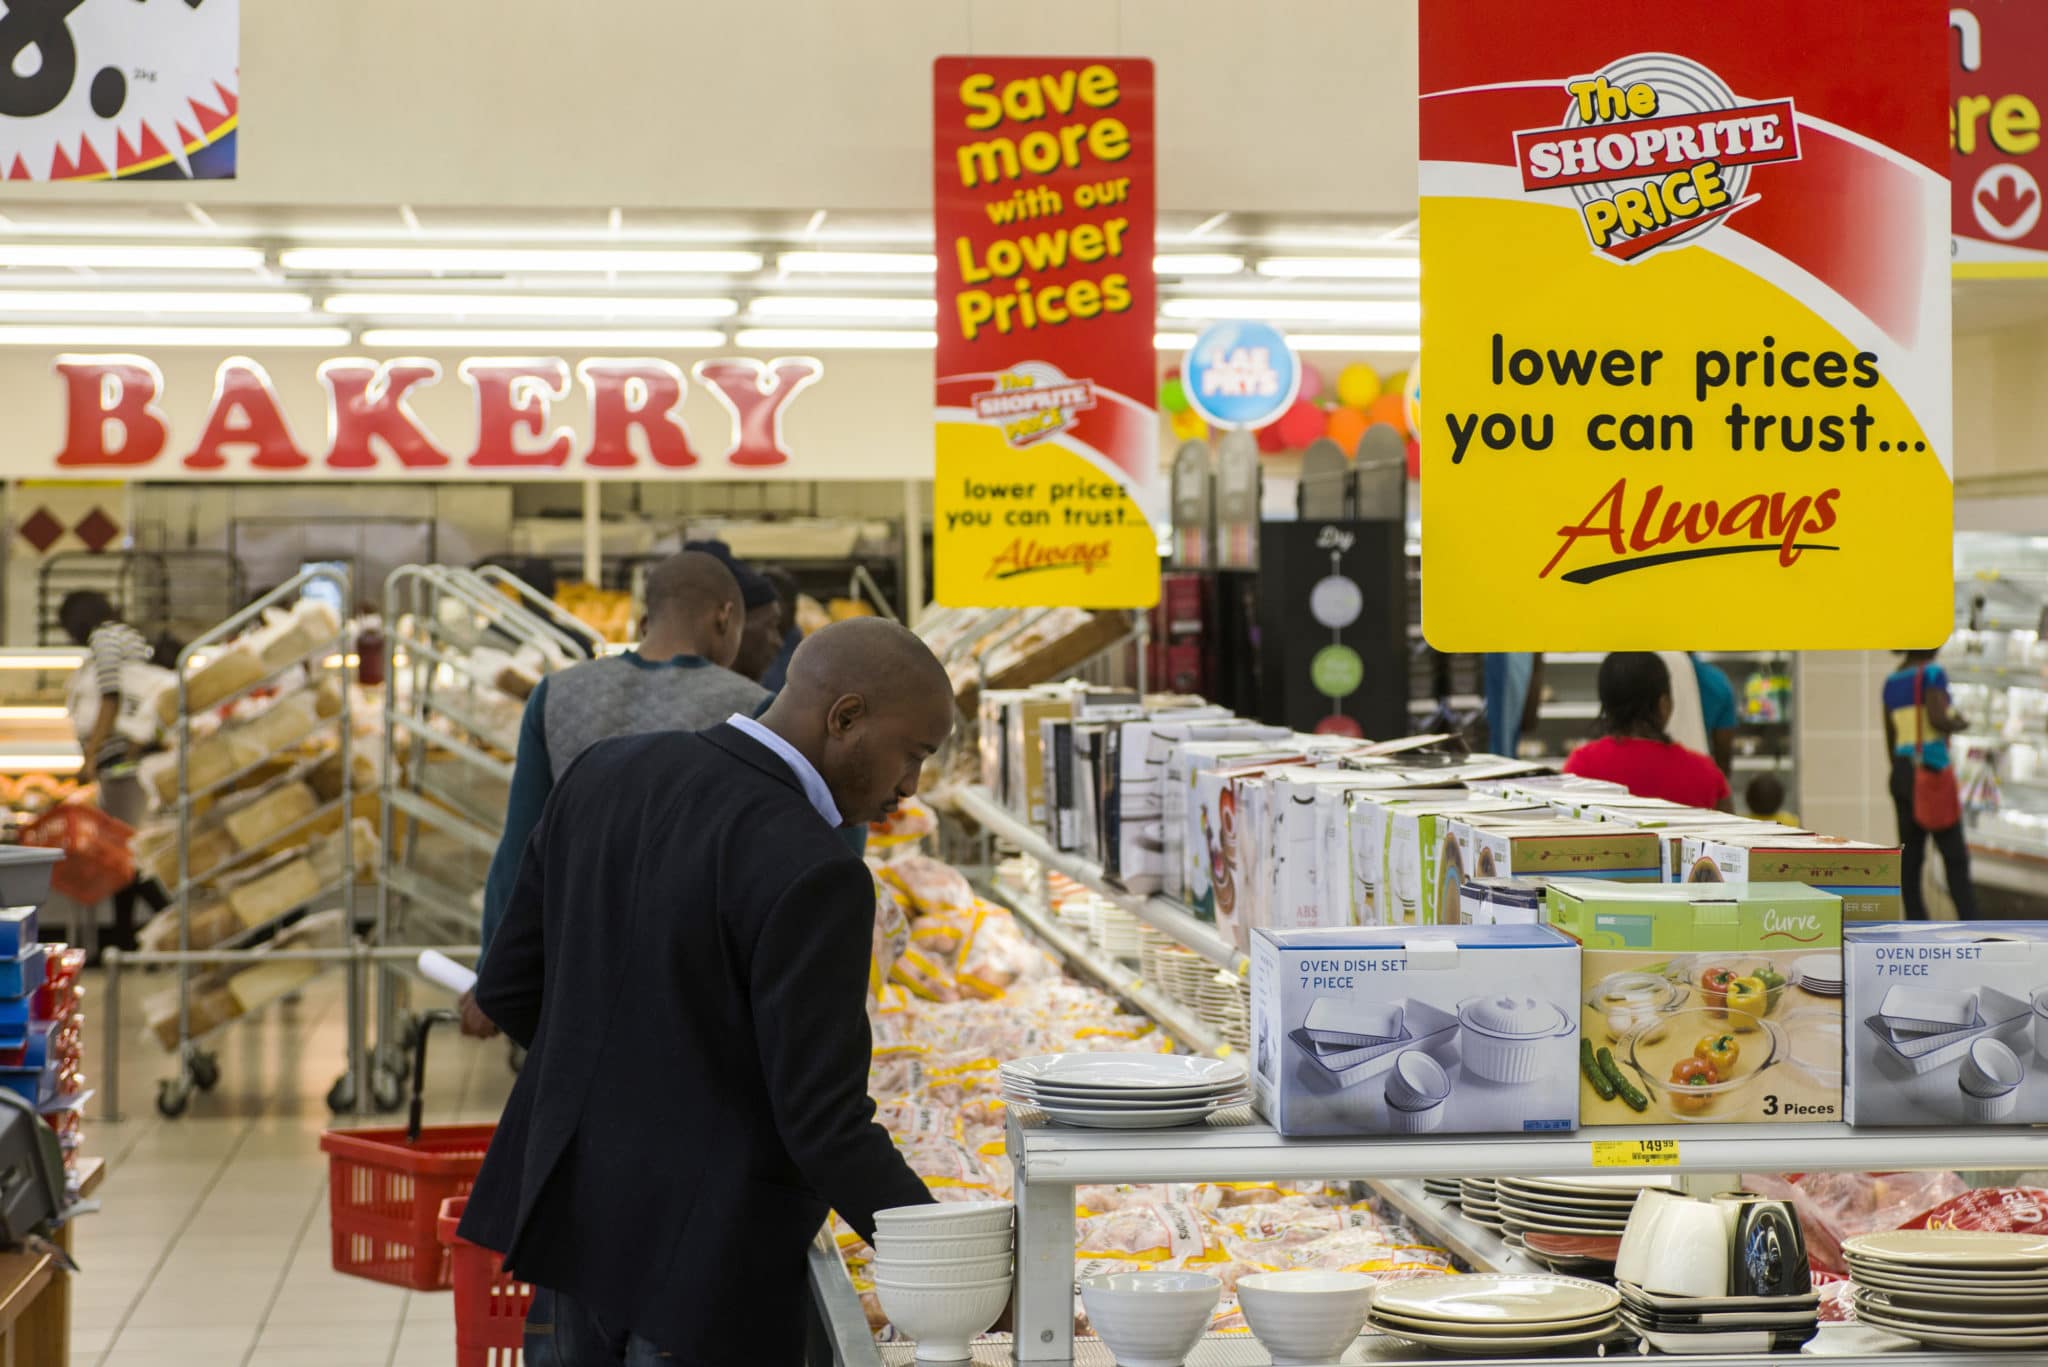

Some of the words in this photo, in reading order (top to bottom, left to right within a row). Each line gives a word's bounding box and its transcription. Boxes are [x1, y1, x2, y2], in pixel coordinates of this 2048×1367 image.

[133, 69, 157, 82] 2kg
[959, 64, 1119, 130] Save
[1570, 77, 1656, 123] The
[1528, 115, 1783, 178] SHOPRITE
[1949, 94, 2041, 155] re
[956, 117, 1131, 187] more
[986, 184, 1063, 225] with
[1074, 177, 1130, 209] our
[1584, 163, 1730, 248] PRICE
[955, 215, 1129, 284] Lower
[956, 272, 1132, 340] Prices
[1492, 333, 1662, 386] lower
[1696, 336, 1879, 402] prices
[50, 354, 824, 470] BAKERY
[979, 385, 1087, 414] SHOPRITE
[1445, 413, 1554, 465] you
[1587, 412, 1693, 452] can
[1726, 403, 1926, 453] trust...
[964, 478, 1037, 498] lower
[1050, 480, 1128, 505] prices
[946, 509, 991, 530] you
[1005, 509, 1050, 526] can
[1538, 477, 1840, 579] Always
[984, 538, 1111, 580] Always
[1763, 909, 1821, 931] Curve
[1861, 903, 1881, 912] SET
[1300, 960, 1339, 972] OVEN
[1344, 960, 1376, 972] DISH
[1381, 959, 1408, 972] SET
[1876, 948, 1914, 960] OVEN
[1919, 948, 1951, 960] DISH
[1956, 947, 1982, 960] SET
[1876, 965, 1884, 976] 7
[1889, 965, 1929, 976] PIECE
[1300, 977, 1308, 989] 7
[1314, 977, 1354, 989] PIECE
[1763, 1095, 1778, 1115] 3
[1784, 1103, 1834, 1114] Pieces
